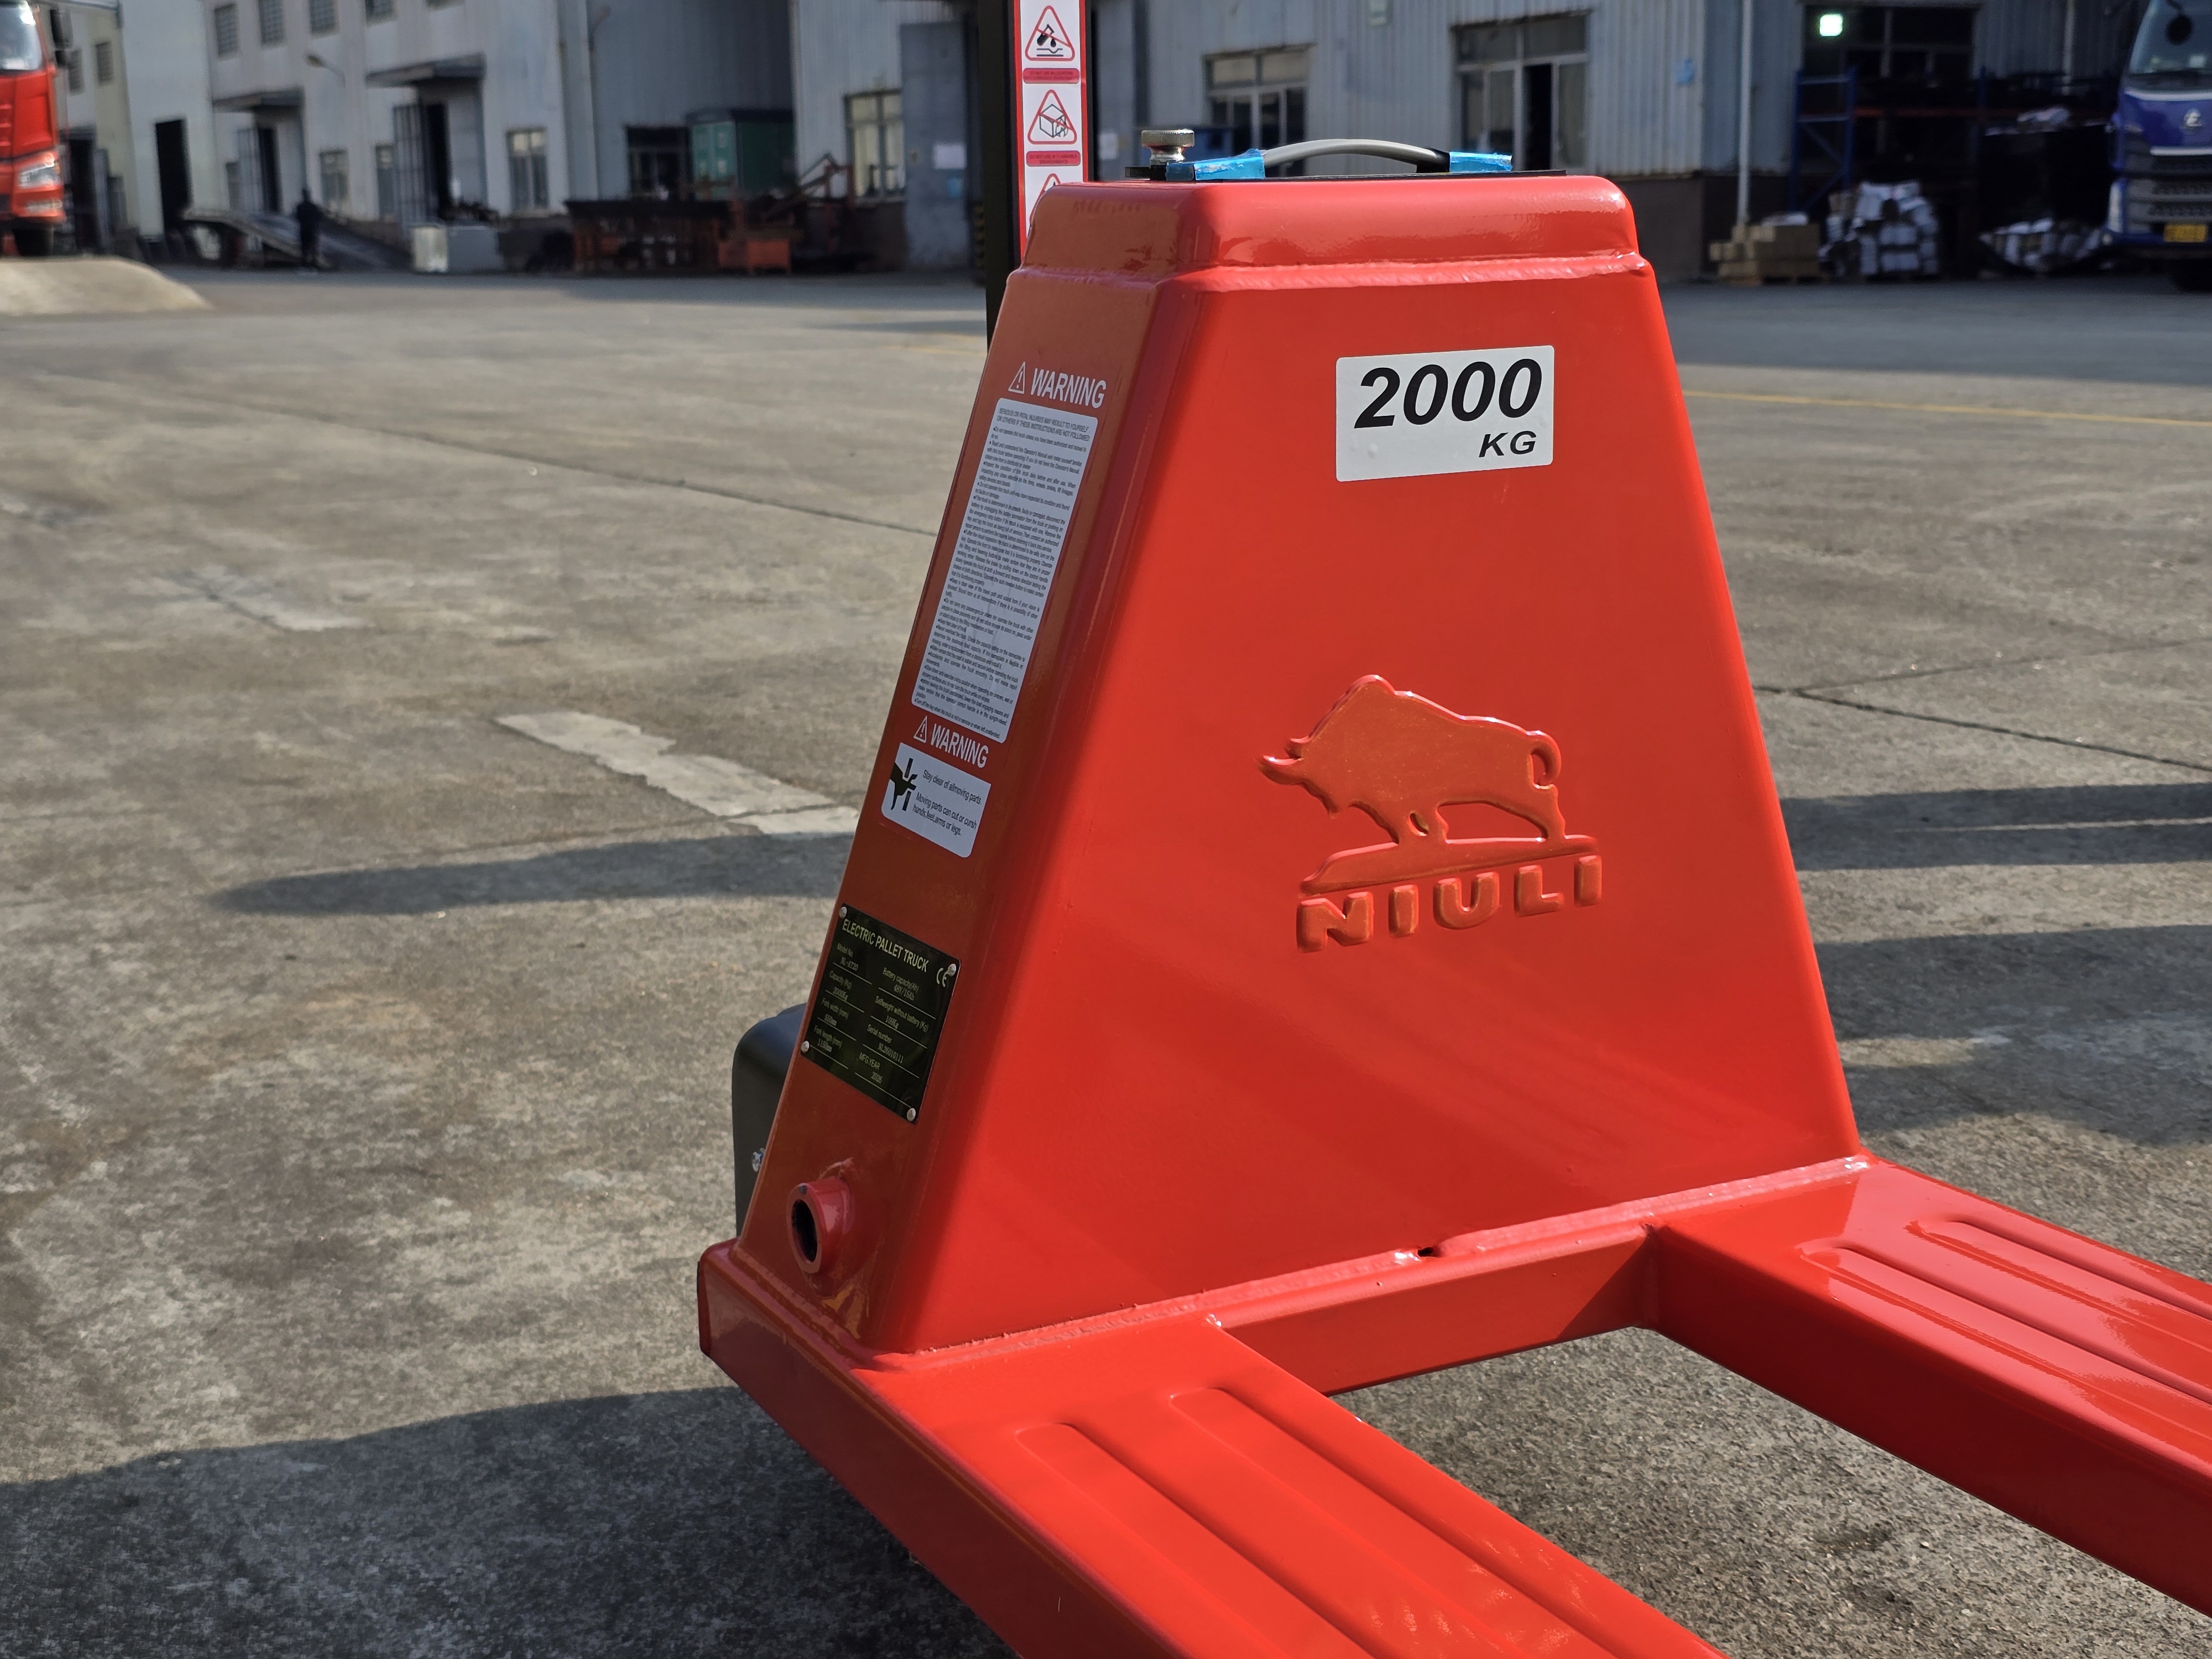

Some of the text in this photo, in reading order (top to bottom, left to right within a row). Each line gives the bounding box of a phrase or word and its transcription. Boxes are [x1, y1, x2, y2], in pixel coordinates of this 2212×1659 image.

[1031, 368, 1107, 409] WARNING
[1354, 358, 1542, 429] 2000
[1479, 430, 1537, 458] KG
[931, 723, 989, 768] WARNING
[923, 769, 933, 782] Stay
[943, 780, 950, 789] of
[916, 792, 931, 808] Moving
[931, 801, 942, 812] parts
[943, 807, 951, 817] can
[1296, 855, 1603, 953] NIULI
[837, 942, 848, 954] Model
[842, 919, 929, 972] ELECTRIC PALLET TRUCK
[830, 971, 844, 985] Capacity
[883, 967, 896, 982] Battery
[907, 1013, 920, 1027] battery
[867, 1024, 892, 1044] Serial number
